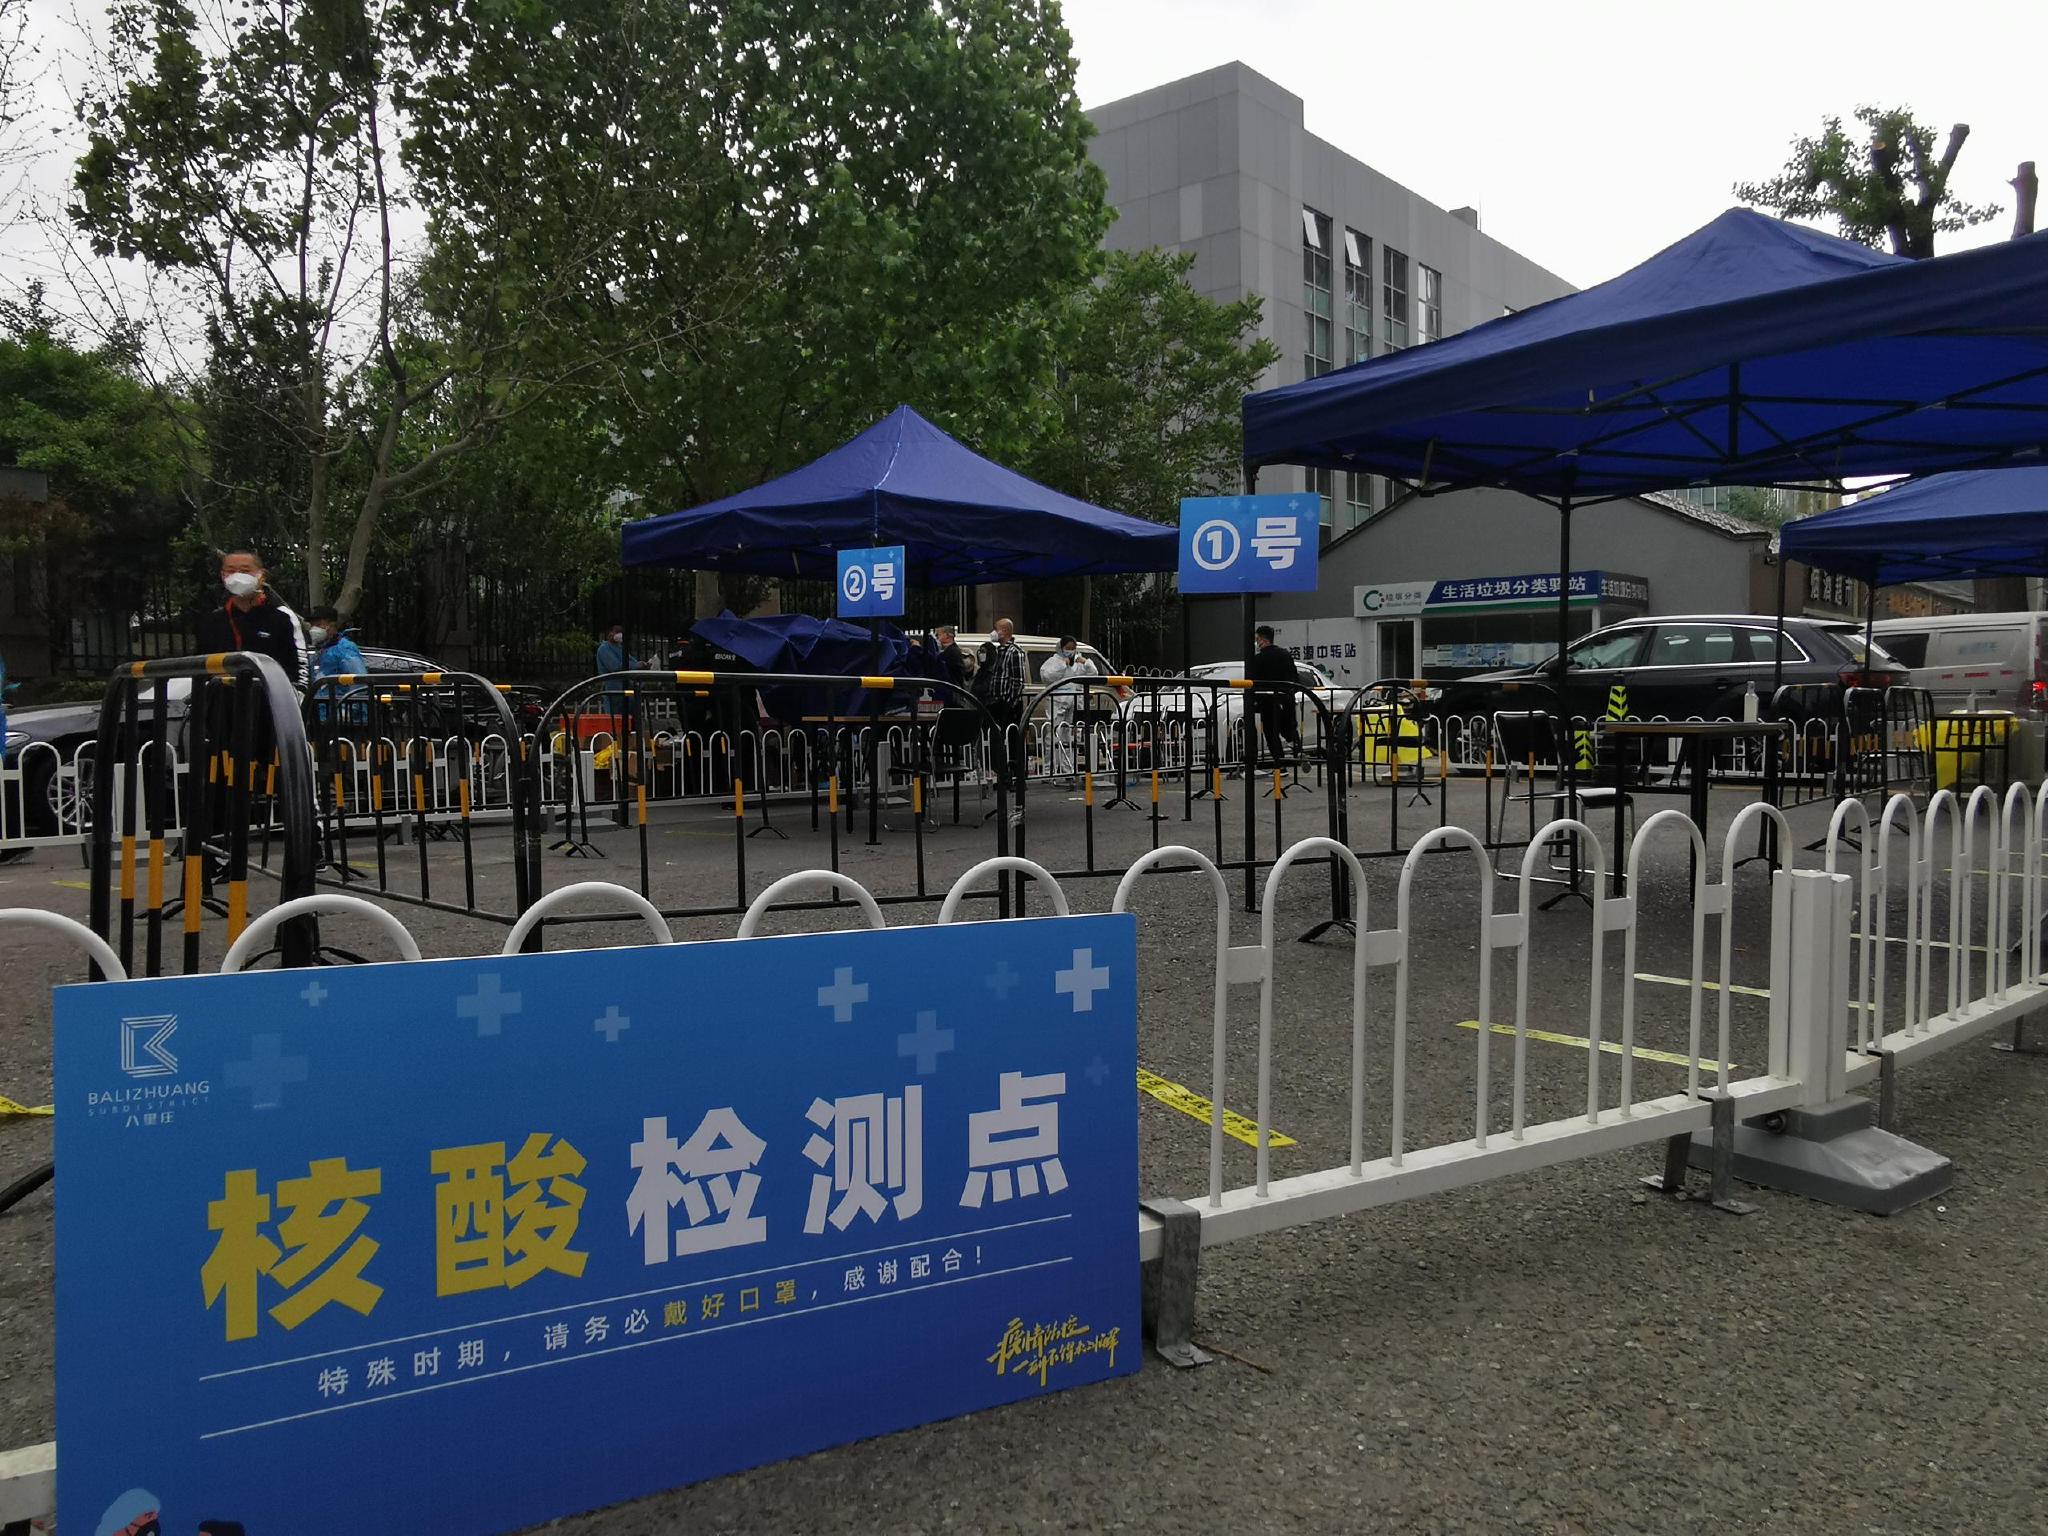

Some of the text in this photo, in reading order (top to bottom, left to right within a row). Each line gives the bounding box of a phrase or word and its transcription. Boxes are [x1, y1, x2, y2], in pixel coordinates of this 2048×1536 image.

[87, 1080, 210, 1106] BALIZHUANG
[125, 1111, 174, 1128] 八里庄
[200, 1071, 1069, 1342] 核酸检测点
